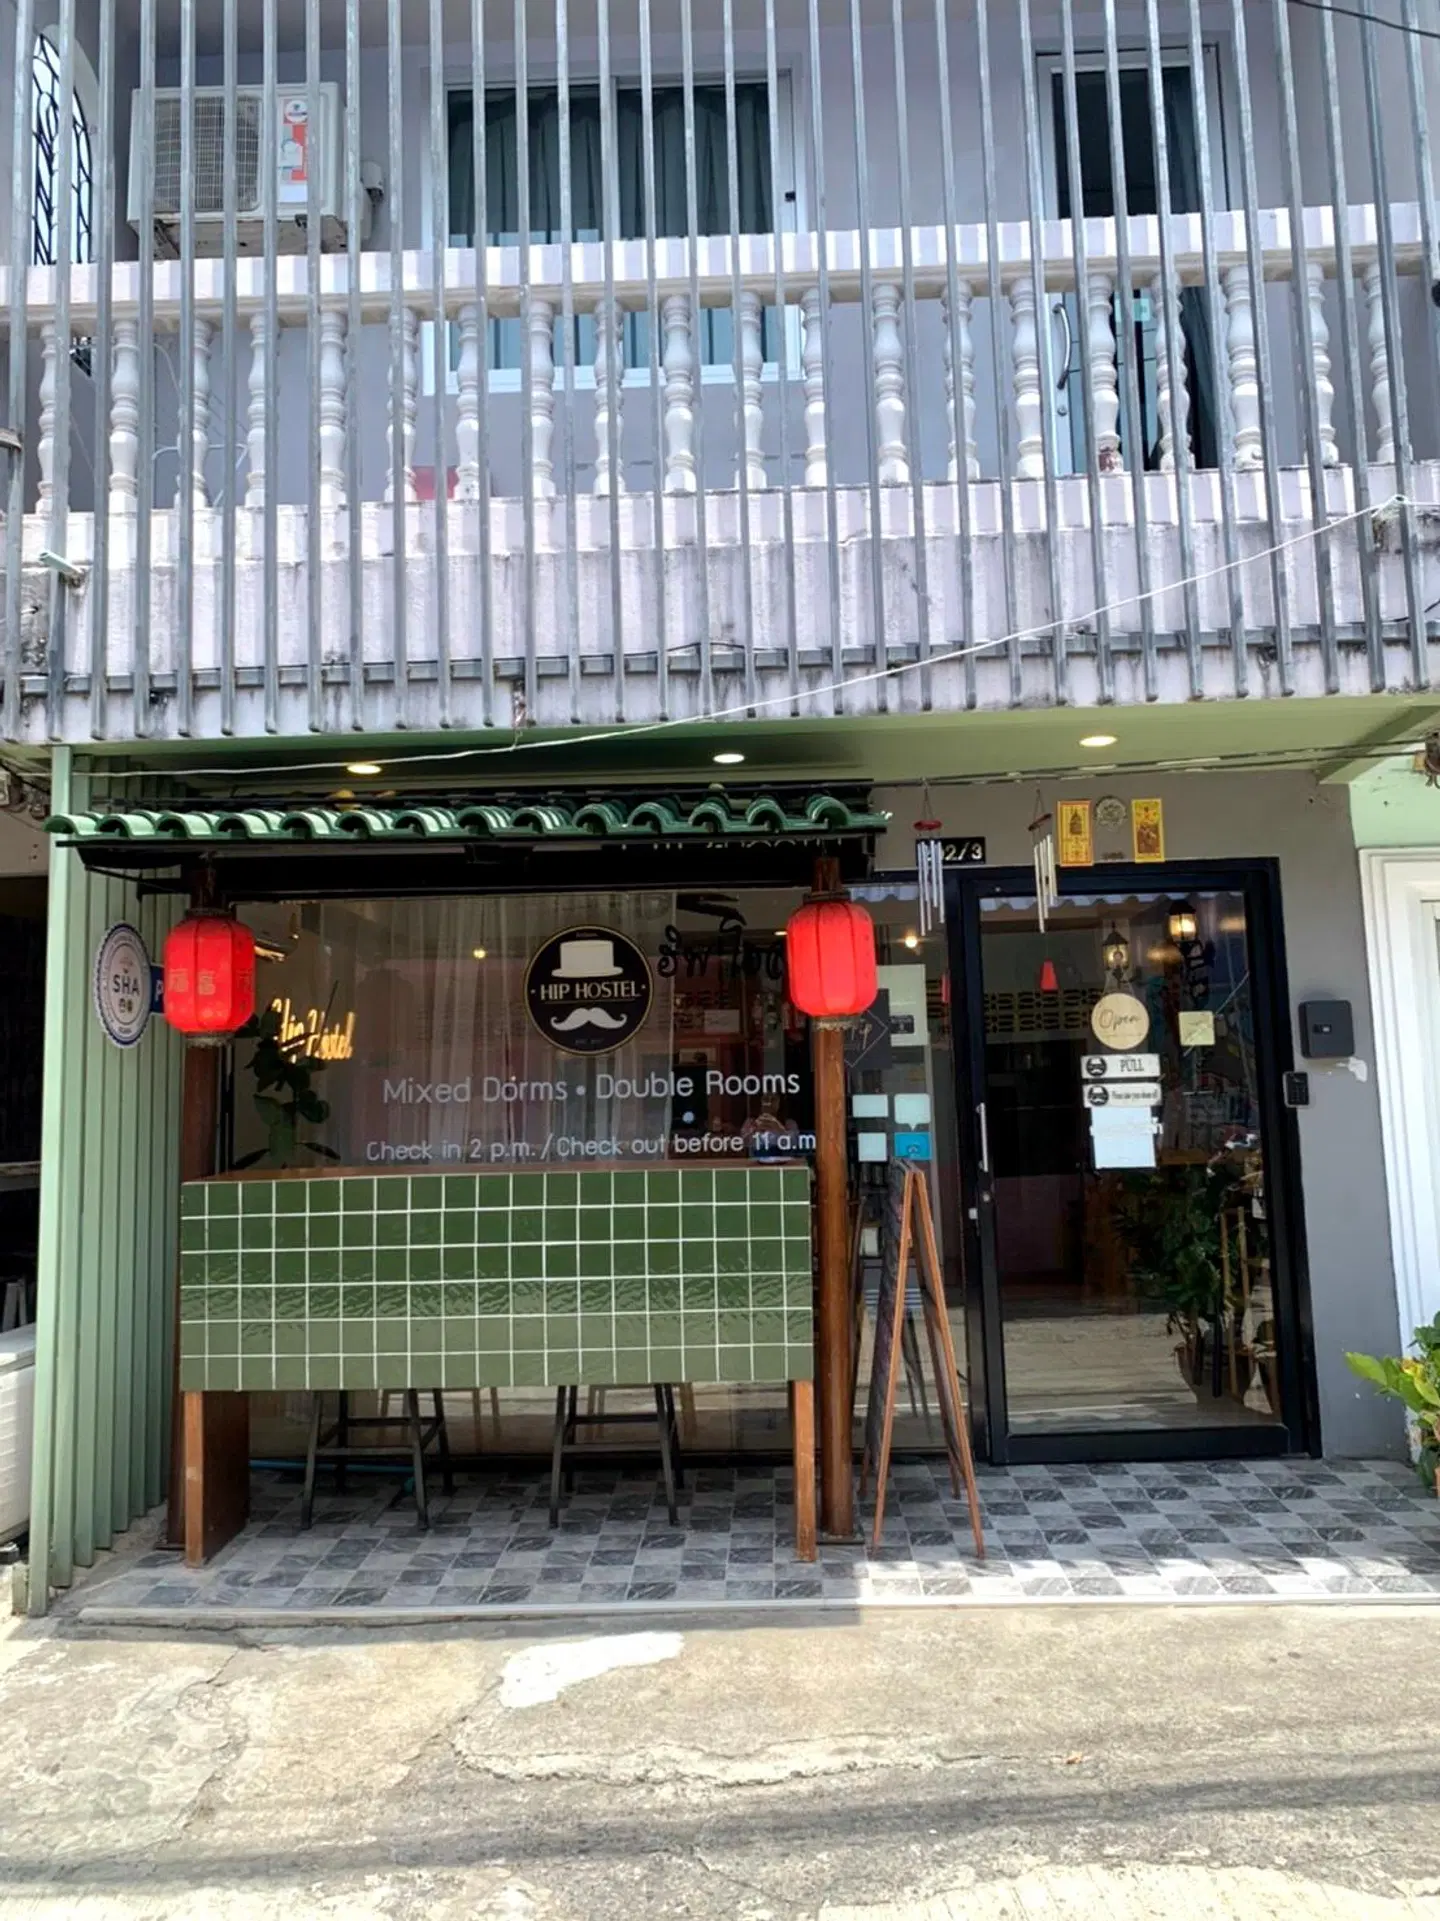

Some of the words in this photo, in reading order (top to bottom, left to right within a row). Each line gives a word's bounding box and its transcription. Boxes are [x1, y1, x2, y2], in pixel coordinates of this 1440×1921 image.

[112, 974, 140, 996] SHA
[540, 983, 571, 1000] HIP
[575, 980, 641, 999] HOSTEL
[1098, 1008, 1142, 1031] Open
[1119, 1058, 1145, 1073] PULL
[382, 1075, 471, 1104] Mixed
[482, 1075, 568, 1102] Dorms
[595, 1071, 694, 1099] Double
[705, 1070, 801, 1096] Rooms
[366, 1139, 433, 1161] Check
[441, 1139, 461, 1159] in
[470, 1138, 482, 1158] 2
[490, 1142, 536, 1163] p.m.
[631, 1134, 667, 1153] out
[674, 1133, 744, 1152] before
[752, 1132, 770, 1150] 11
